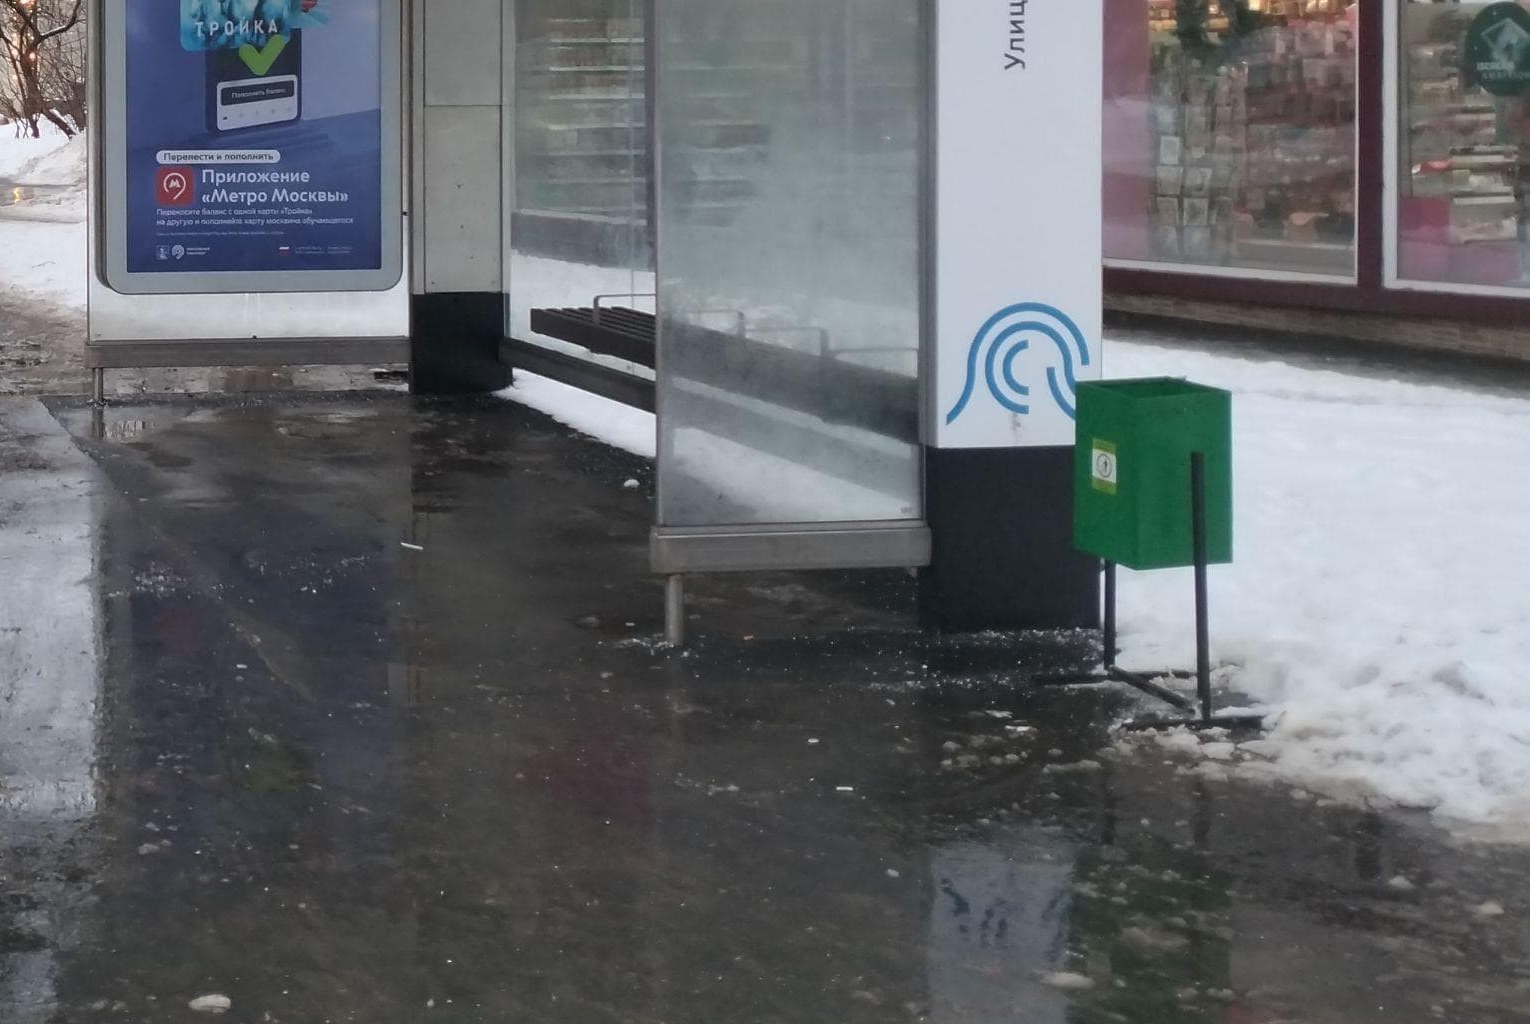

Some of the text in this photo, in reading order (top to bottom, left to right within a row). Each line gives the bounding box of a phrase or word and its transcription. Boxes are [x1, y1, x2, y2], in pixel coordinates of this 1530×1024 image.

[194, 17, 279, 37] ТРОЙКА
[163, 152, 214, 162] Перевести
[224, 154, 274, 162] пополнить
[201, 169, 310, 186] Приложение
[201, 188, 349, 205] «Метро Москвы»
